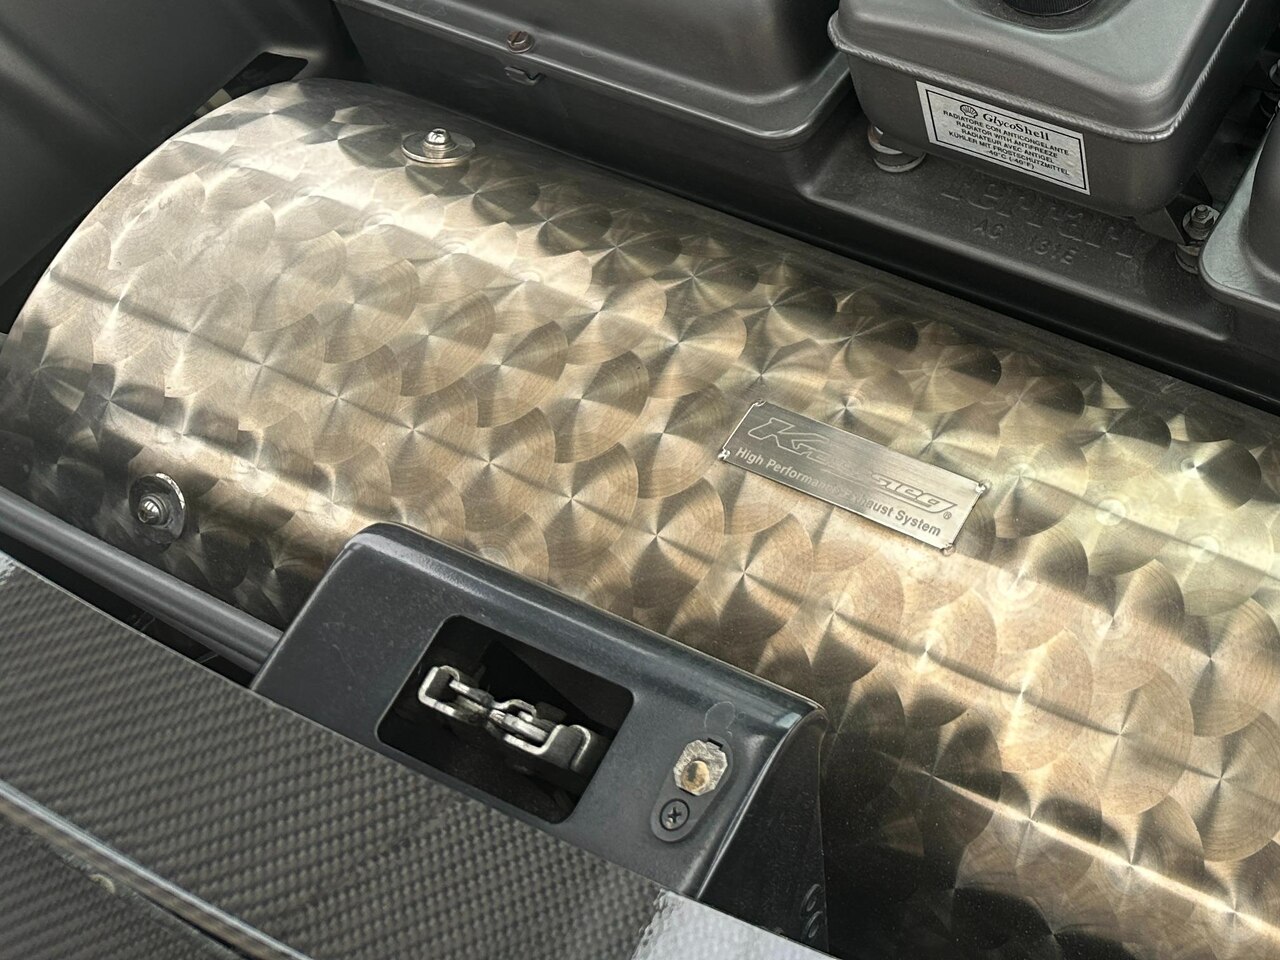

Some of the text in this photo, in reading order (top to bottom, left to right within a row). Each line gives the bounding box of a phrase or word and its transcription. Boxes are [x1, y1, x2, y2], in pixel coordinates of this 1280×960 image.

[942, 109, 1068, 155] RADIATORE CON ANTICONGELANTE
[955, 120, 1057, 158] RADIATOR WITH ANTIFREEZE
[982, 113, 1049, 140] GlycoShell
[961, 128, 1054, 163] RADIATEUR AVEC ANTIGEL
[978, 140, 991, 148] MIT
[992, 145, 1069, 175] FROSTSCHUTZMITTEL
[735, 446, 764, 467] High
[894, 508, 942, 537] System
